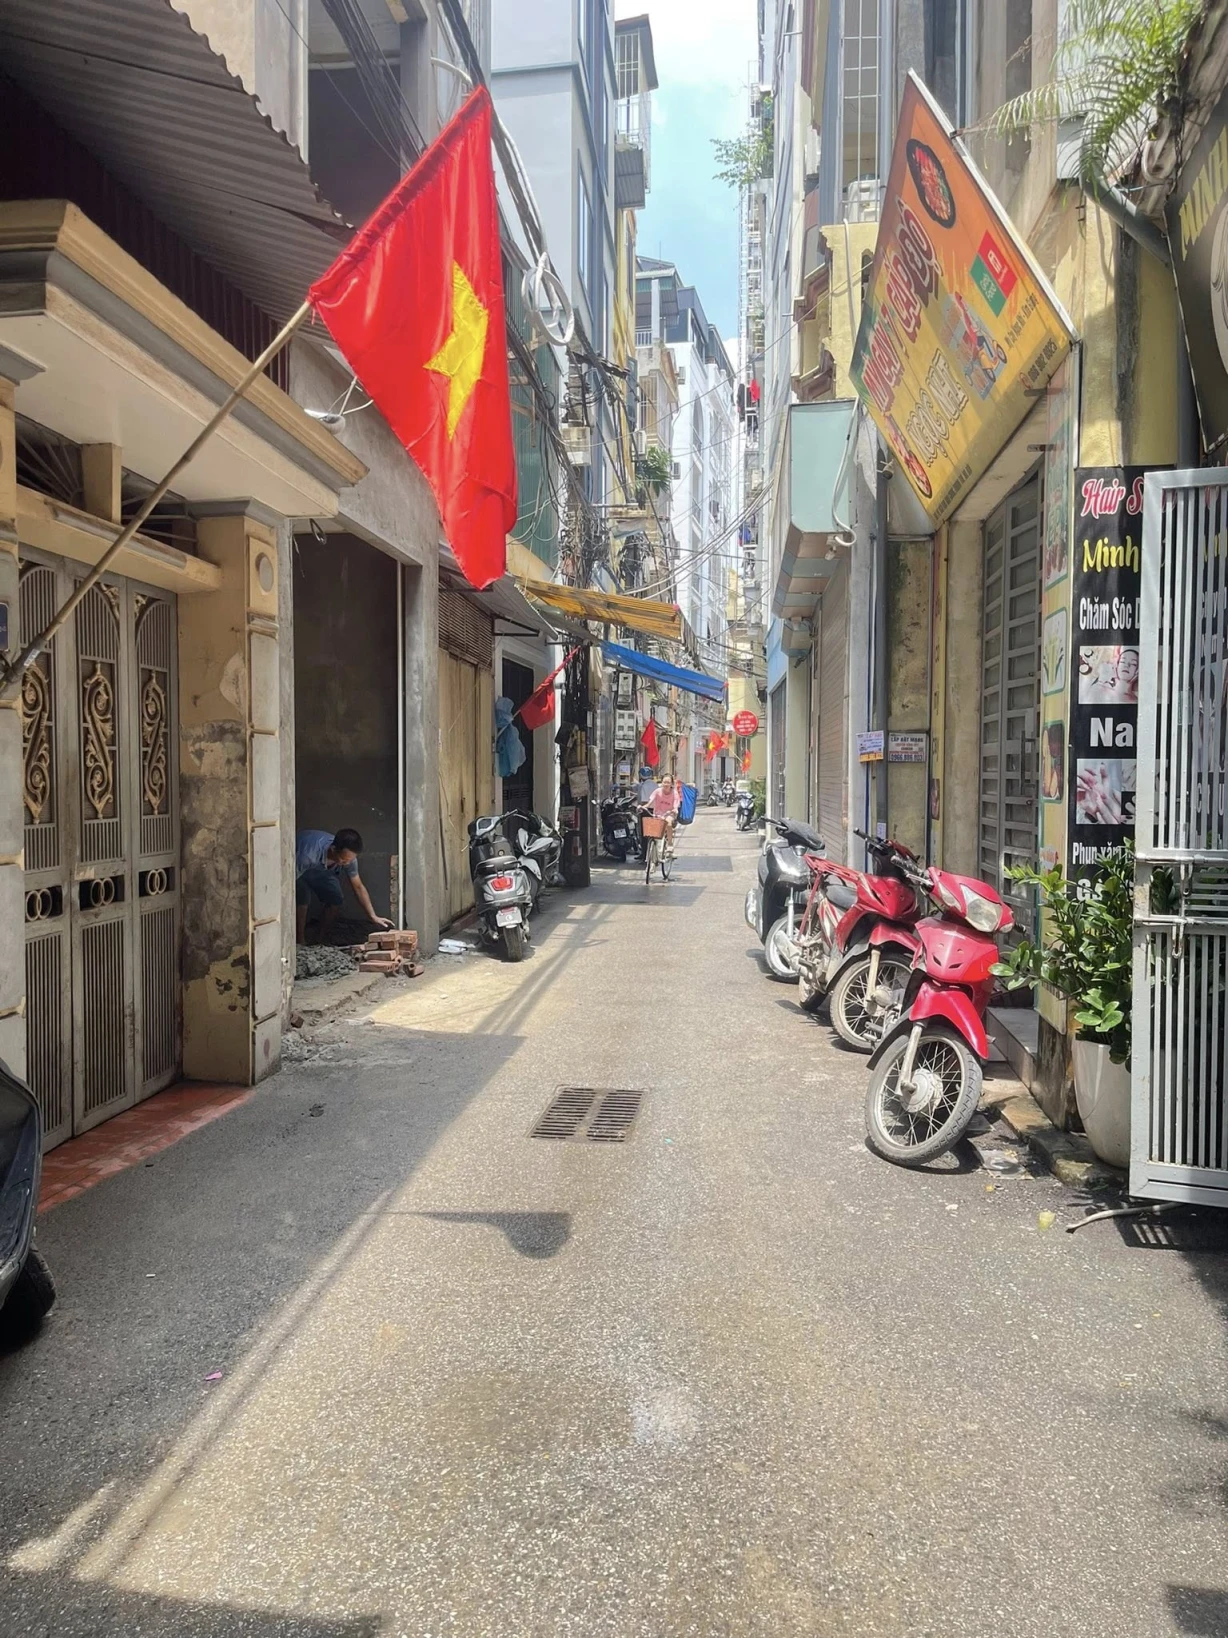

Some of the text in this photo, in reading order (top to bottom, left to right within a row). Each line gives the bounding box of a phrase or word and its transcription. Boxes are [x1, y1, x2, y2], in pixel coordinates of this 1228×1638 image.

[896, 195, 941, 287] ĐỘ
[880, 248, 921, 335] CẤP
[869, 319, 901, 387] CAY
[880, 302, 907, 352] 7
[925, 348, 968, 426] NHI
[906, 388, 949, 466] NGỌC
[1081, 478, 1125, 518] Hair
[1083, 535, 1139, 573] Minh
[1080, 596, 1109, 630] Chăm
[1112, 596, 1132, 630] Sóc
[1090, 717, 1134, 748] Na
